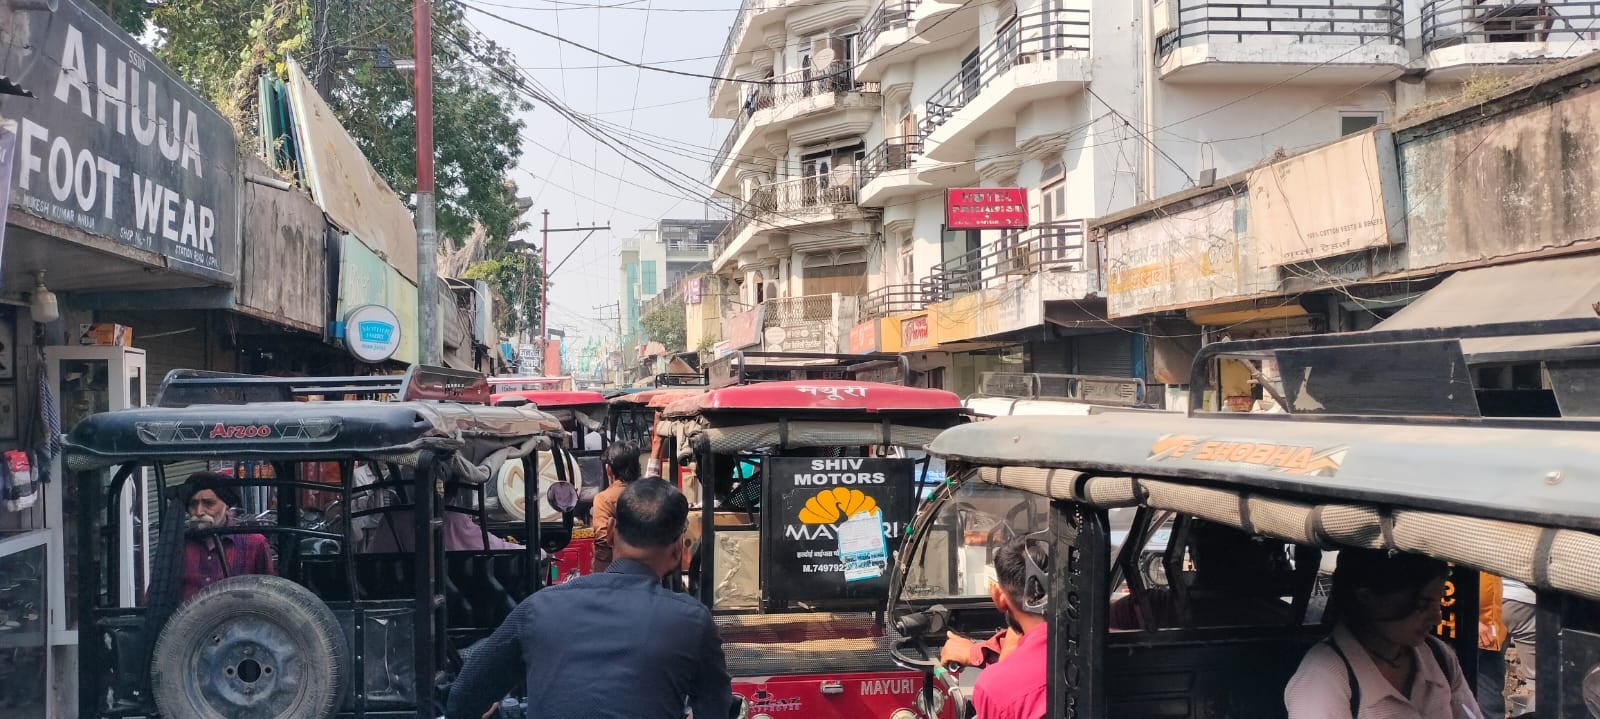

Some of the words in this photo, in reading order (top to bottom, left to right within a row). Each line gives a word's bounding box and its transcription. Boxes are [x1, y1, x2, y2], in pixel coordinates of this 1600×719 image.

[54, 24, 203, 177] AHUJA
[19, 118, 120, 219] FOOT
[133, 173, 215, 253] WEAR
[962, 191, 1012, 203] HOTEL
[53, 204, 75, 222] KUMAR
[78, 213, 95, 230] AHUJA
[120, 227, 133, 241] SHOP
[1320, 225, 1340, 236] COTTON
[1341, 221, 1357, 233] VESTS
[175, 244, 193, 259] STATION
[210, 423, 271, 438] Arzoo
[1194, 440, 1313, 469] SHOBHA
[811, 459, 863, 471] SHIV
[794, 472, 886, 486] MOTORS
[785, 521, 898, 541] MARI
[861, 680, 914, 696] MAYURI
